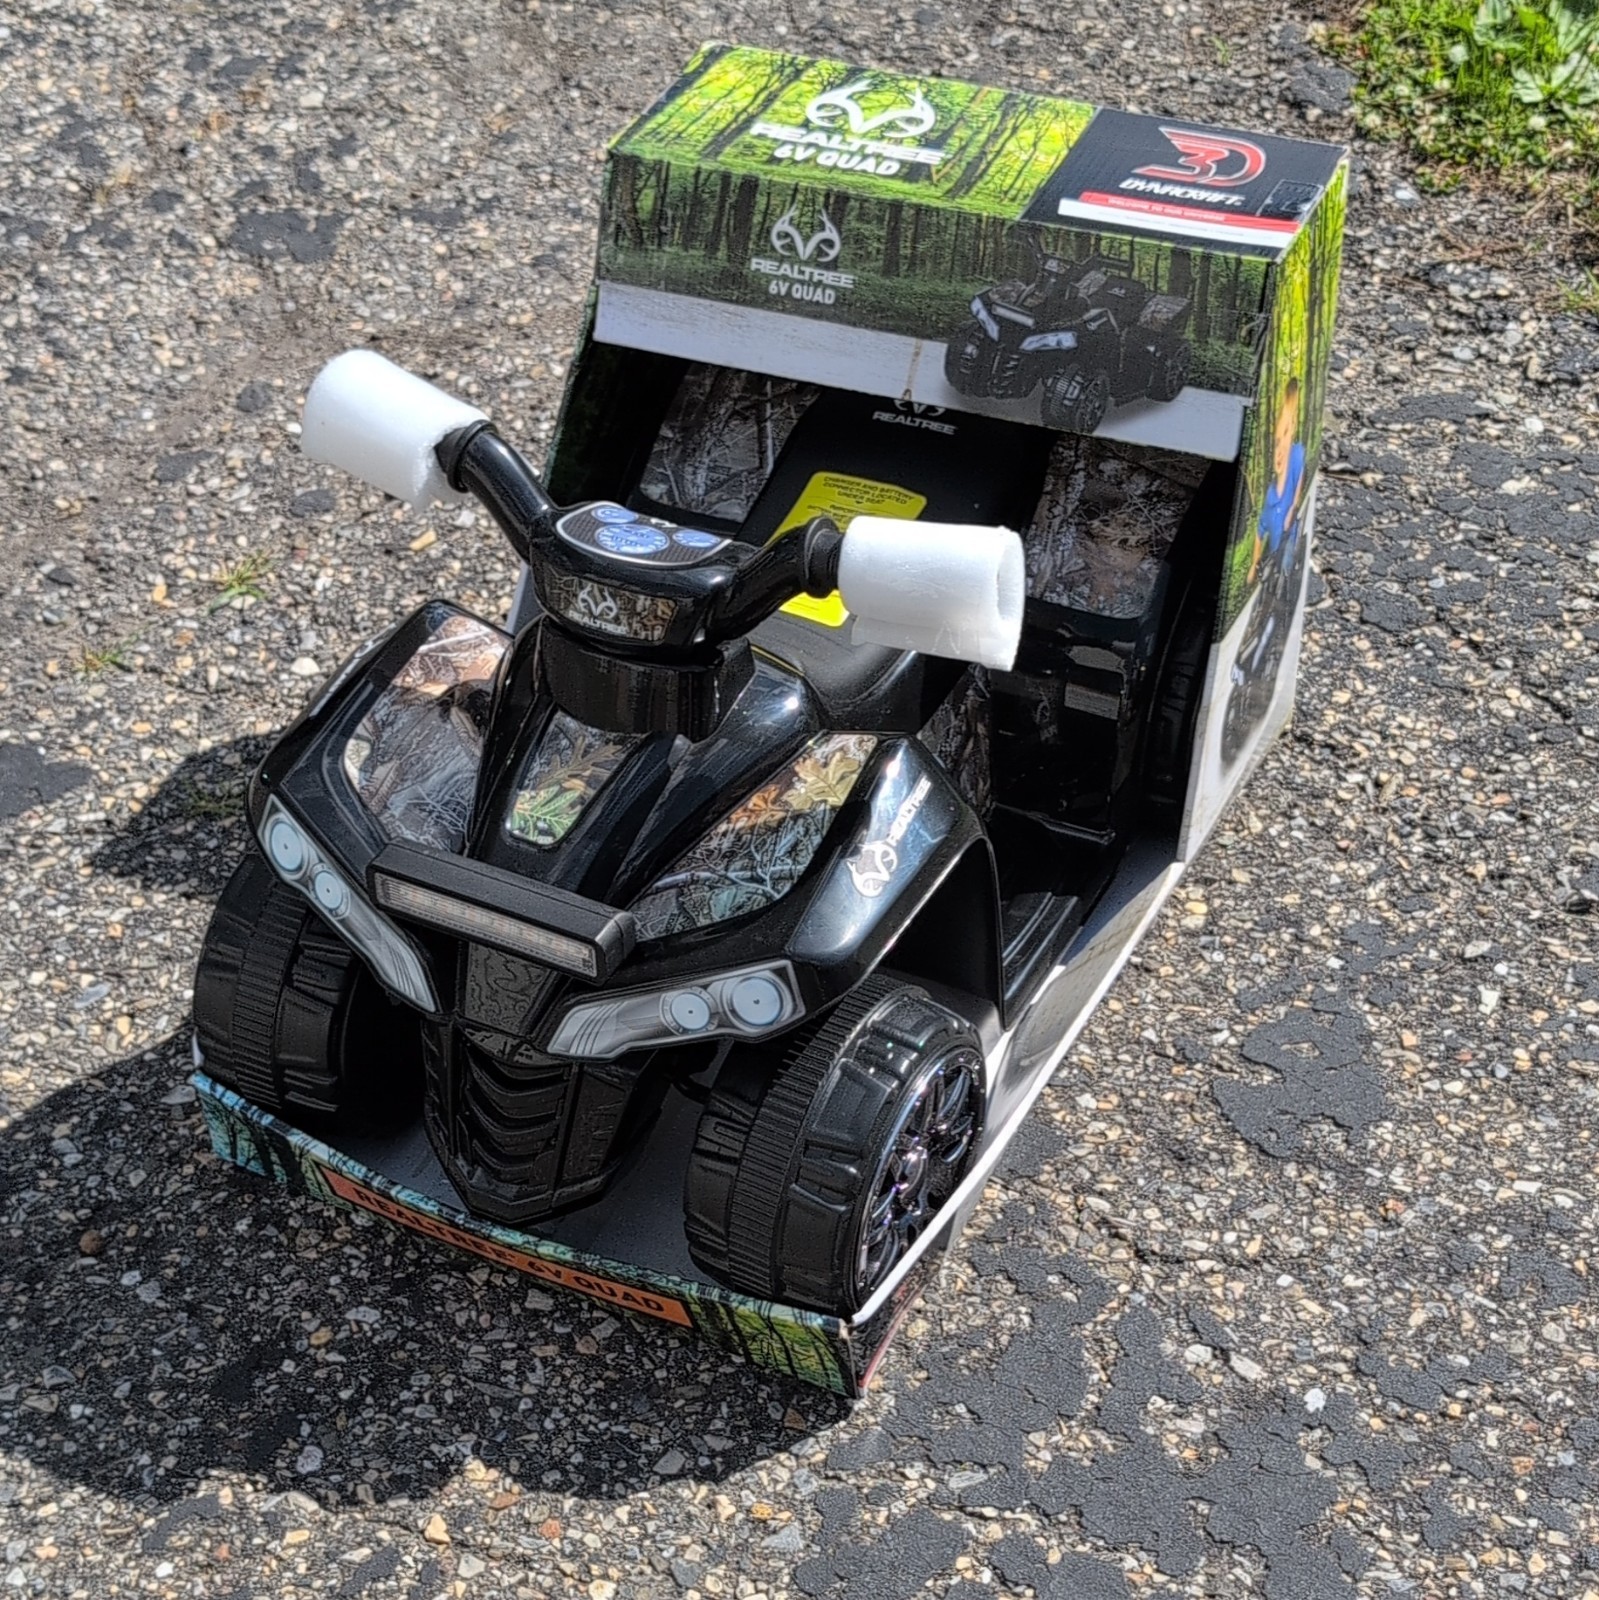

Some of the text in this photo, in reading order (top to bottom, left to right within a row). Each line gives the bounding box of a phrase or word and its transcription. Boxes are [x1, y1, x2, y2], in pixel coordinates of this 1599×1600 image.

[749, 122, 945, 165] REALTREE
[773, 143, 901, 176] 6V QUAD
[750, 257, 855, 289] REALTREE
[768, 279, 836, 305] 6V QUAD
[872, 410, 957, 436] REALTREE
[568, 609, 631, 635] REALTREE
[885, 774, 932, 847] REALTREE
[527, 1260, 562, 1280] 6V
[573, 1275, 665, 1313] QUAD
